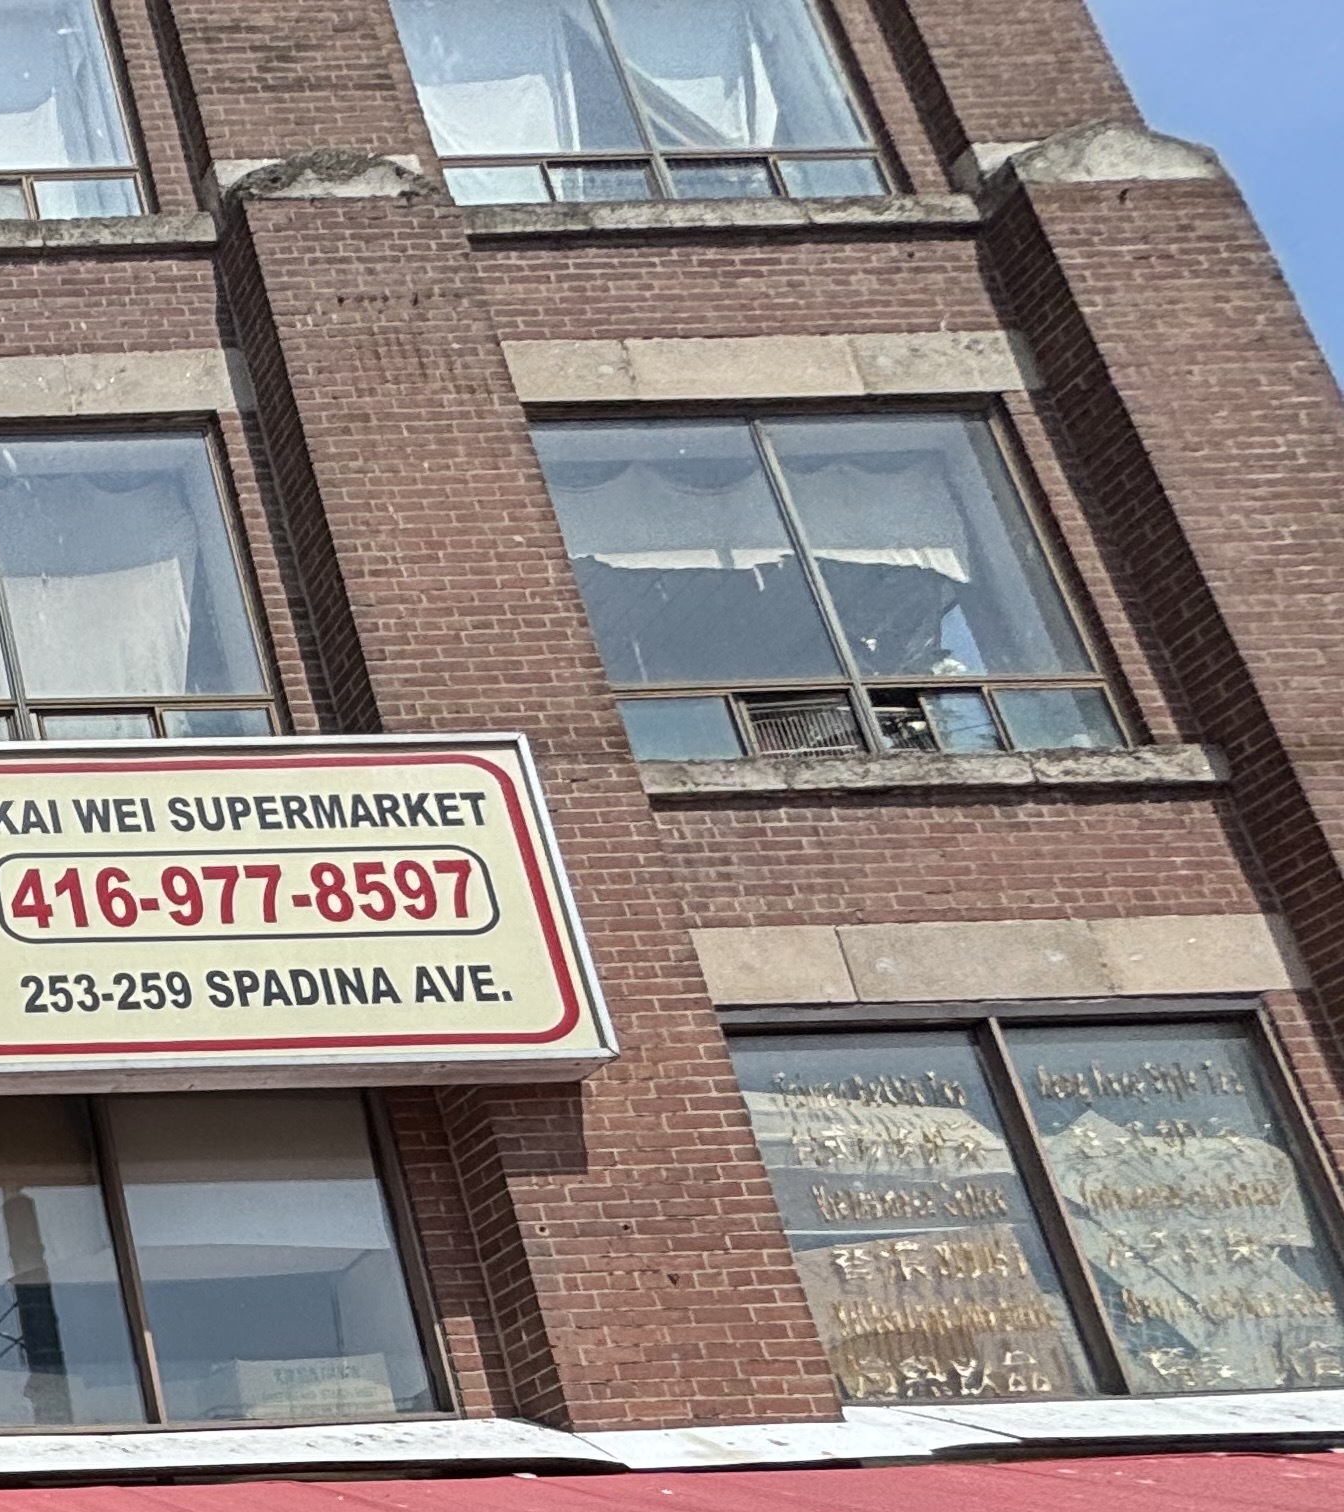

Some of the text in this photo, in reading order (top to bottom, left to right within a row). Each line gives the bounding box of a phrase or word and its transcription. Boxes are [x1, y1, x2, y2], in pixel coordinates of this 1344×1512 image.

[72, 797, 155, 833] WEI
[170, 791, 486, 831] SUPERMARKET
[10, 858, 473, 930] 416-977-8597
[19, 964, 512, 1014] 253-259 SPADINA AVE.
